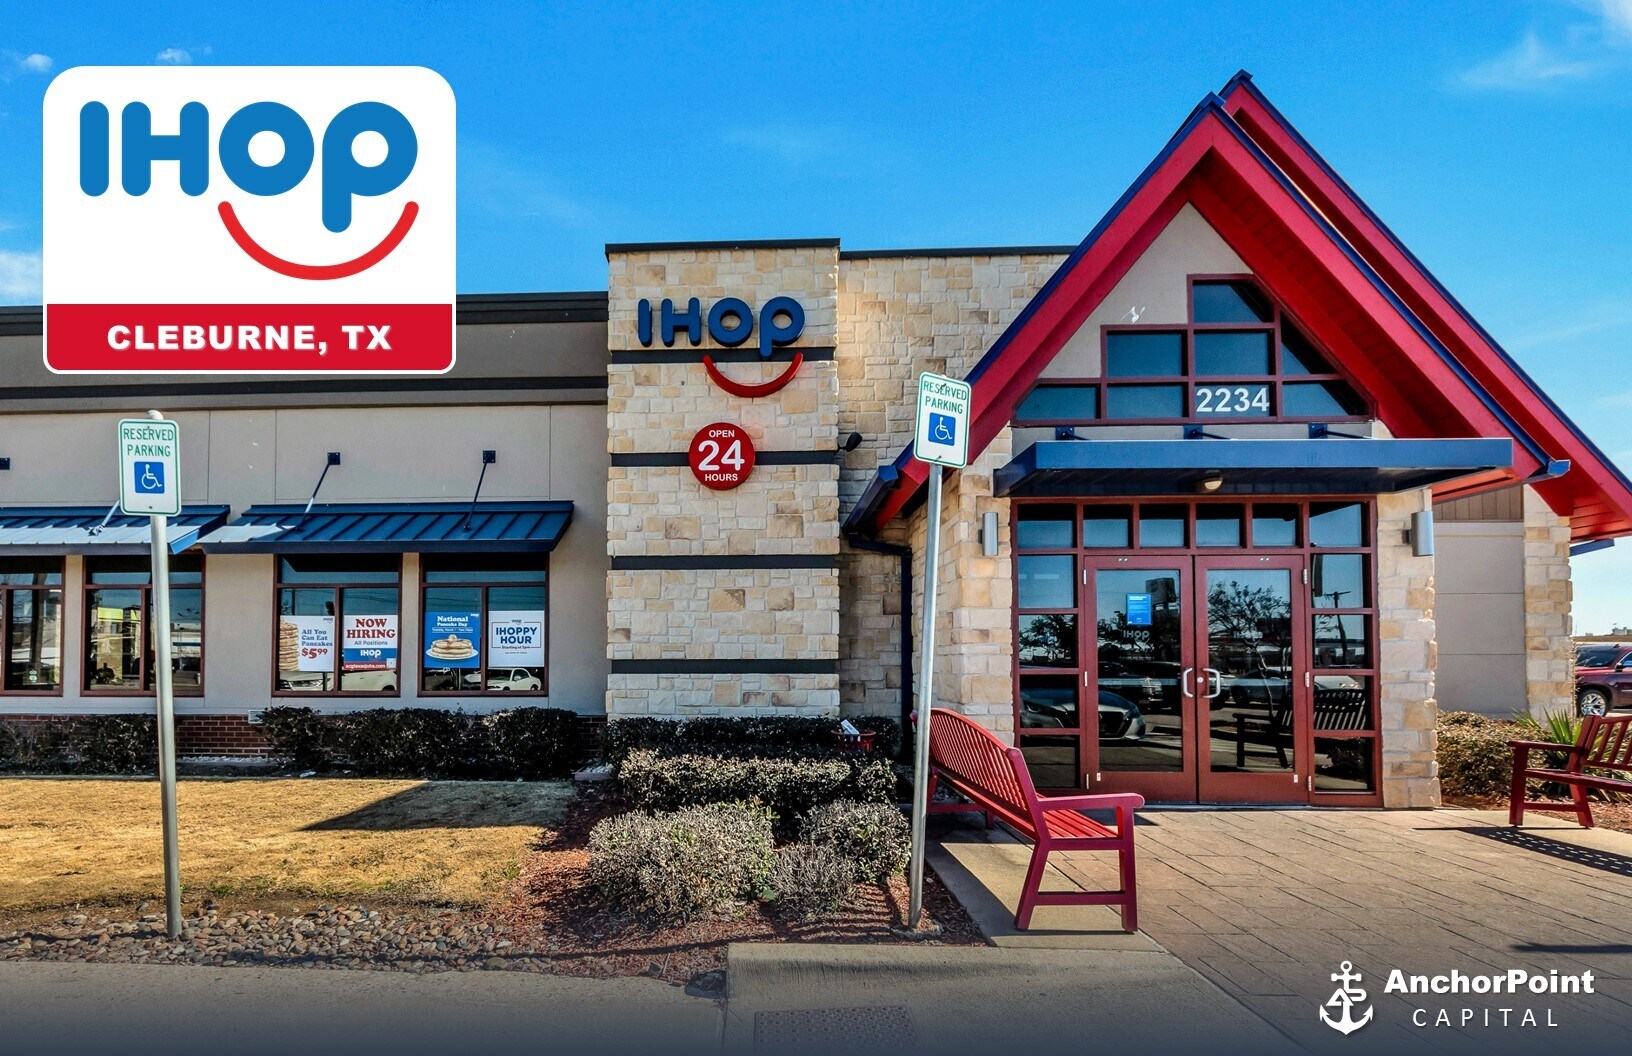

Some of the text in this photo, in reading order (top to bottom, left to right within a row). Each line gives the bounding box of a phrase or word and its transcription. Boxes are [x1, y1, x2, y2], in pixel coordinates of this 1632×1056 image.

[923, 380, 967, 401] RESERVED
[924, 395, 963, 414] PARKING
[1196, 387, 1270, 412] 2234
[123, 428, 174, 441] RESERVED
[708, 429, 735, 438] OPEN
[127, 444, 171, 457] PARKING
[698, 439, 746, 471] 24
[704, 473, 739, 482] HOURS
[355, 618, 387, 628] NOW
[346, 629, 396, 639] HIRING
[495, 627, 538, 636] IHOPPY
[500, 635, 532, 645] HOUR
